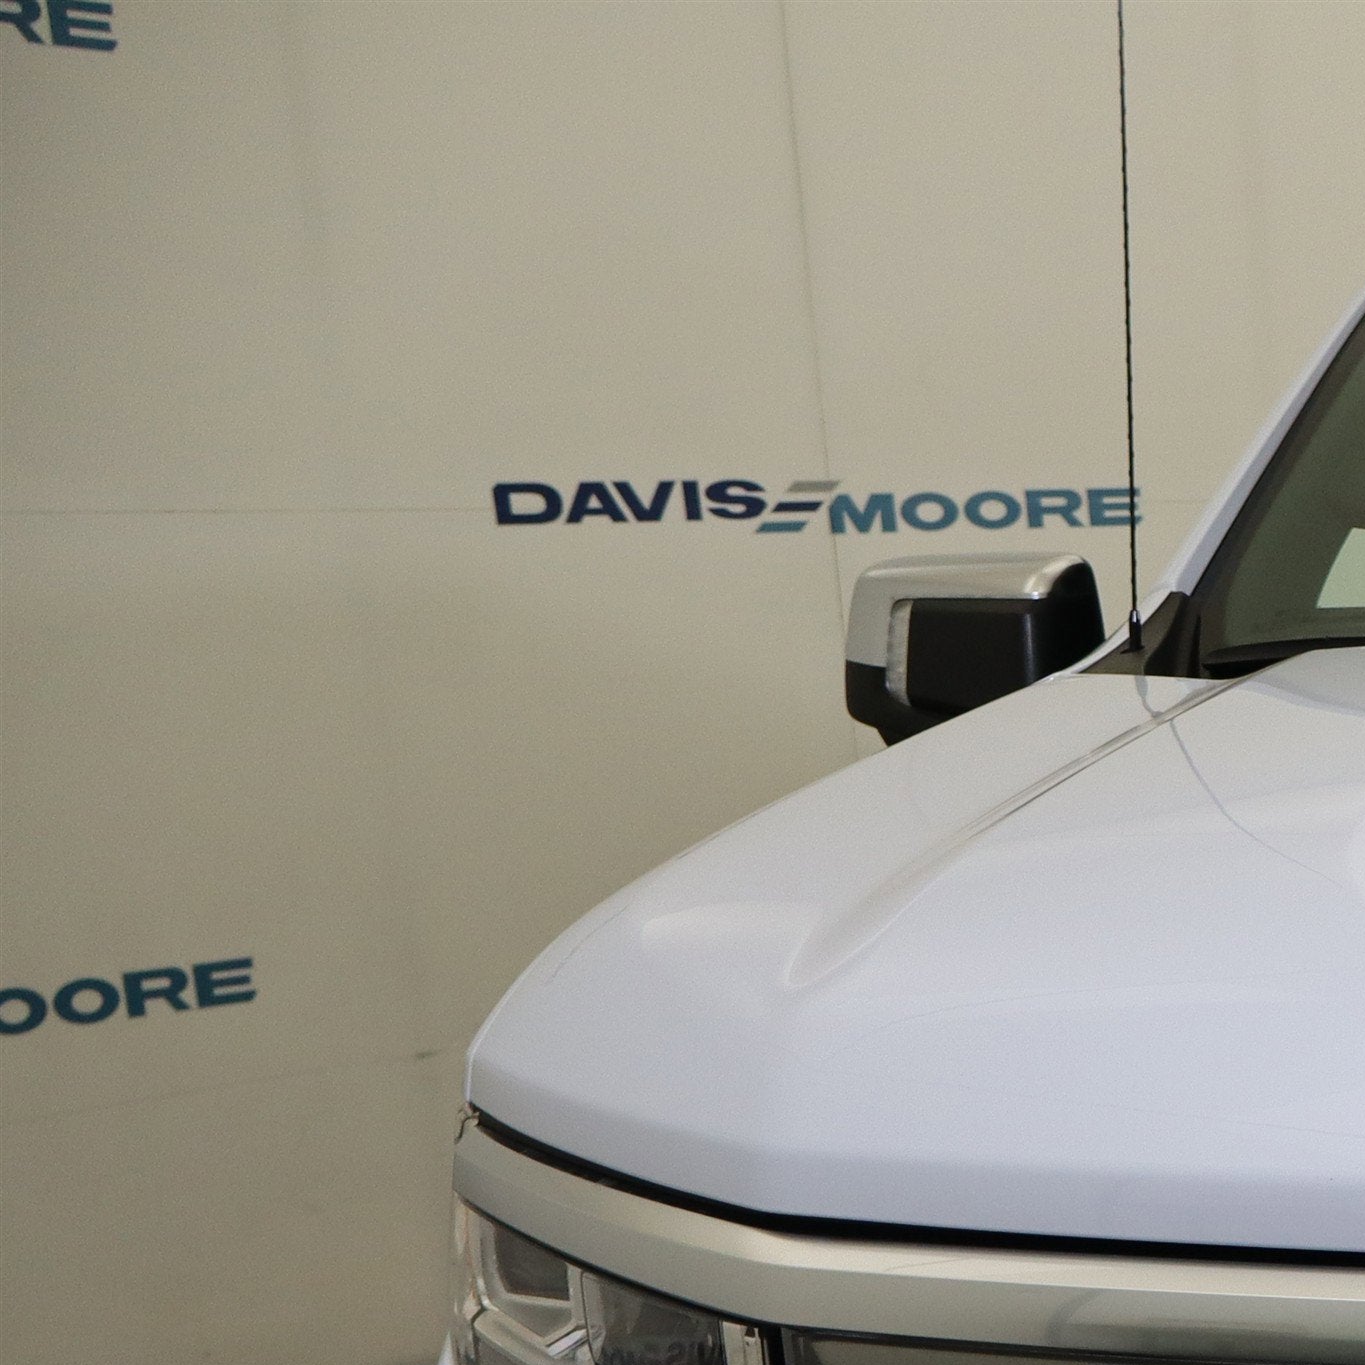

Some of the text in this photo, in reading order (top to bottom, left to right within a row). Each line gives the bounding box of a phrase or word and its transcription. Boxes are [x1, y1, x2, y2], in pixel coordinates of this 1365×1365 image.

[492, 479, 1142, 534] DAVIS MOORE
[0, 956, 257, 1035] OORE
